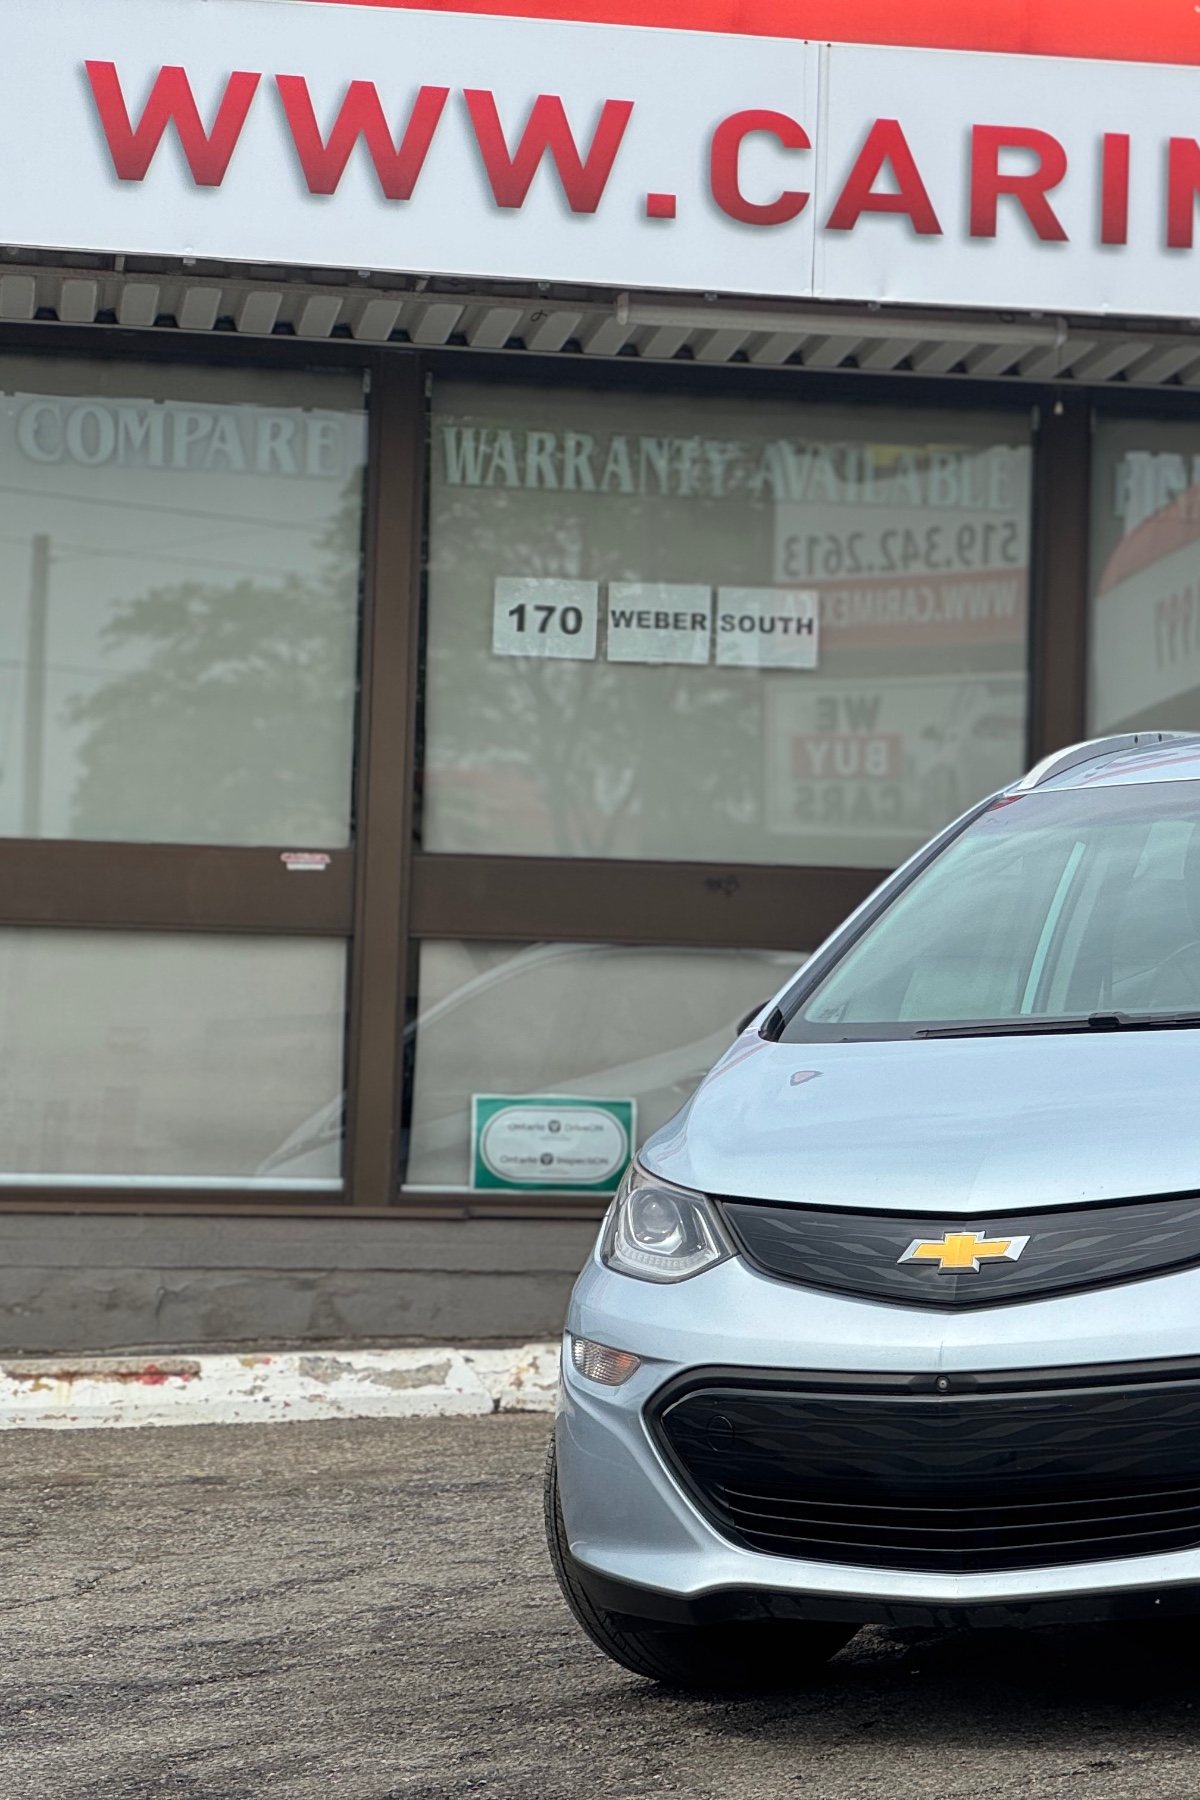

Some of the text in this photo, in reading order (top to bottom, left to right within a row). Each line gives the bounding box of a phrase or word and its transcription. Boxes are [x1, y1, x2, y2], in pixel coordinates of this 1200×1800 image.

[16, 402, 342, 478] COMPARE
[443, 426, 731, 496] WARRANTY
[508, 603, 814, 635] 170 WEBER SOUTH
